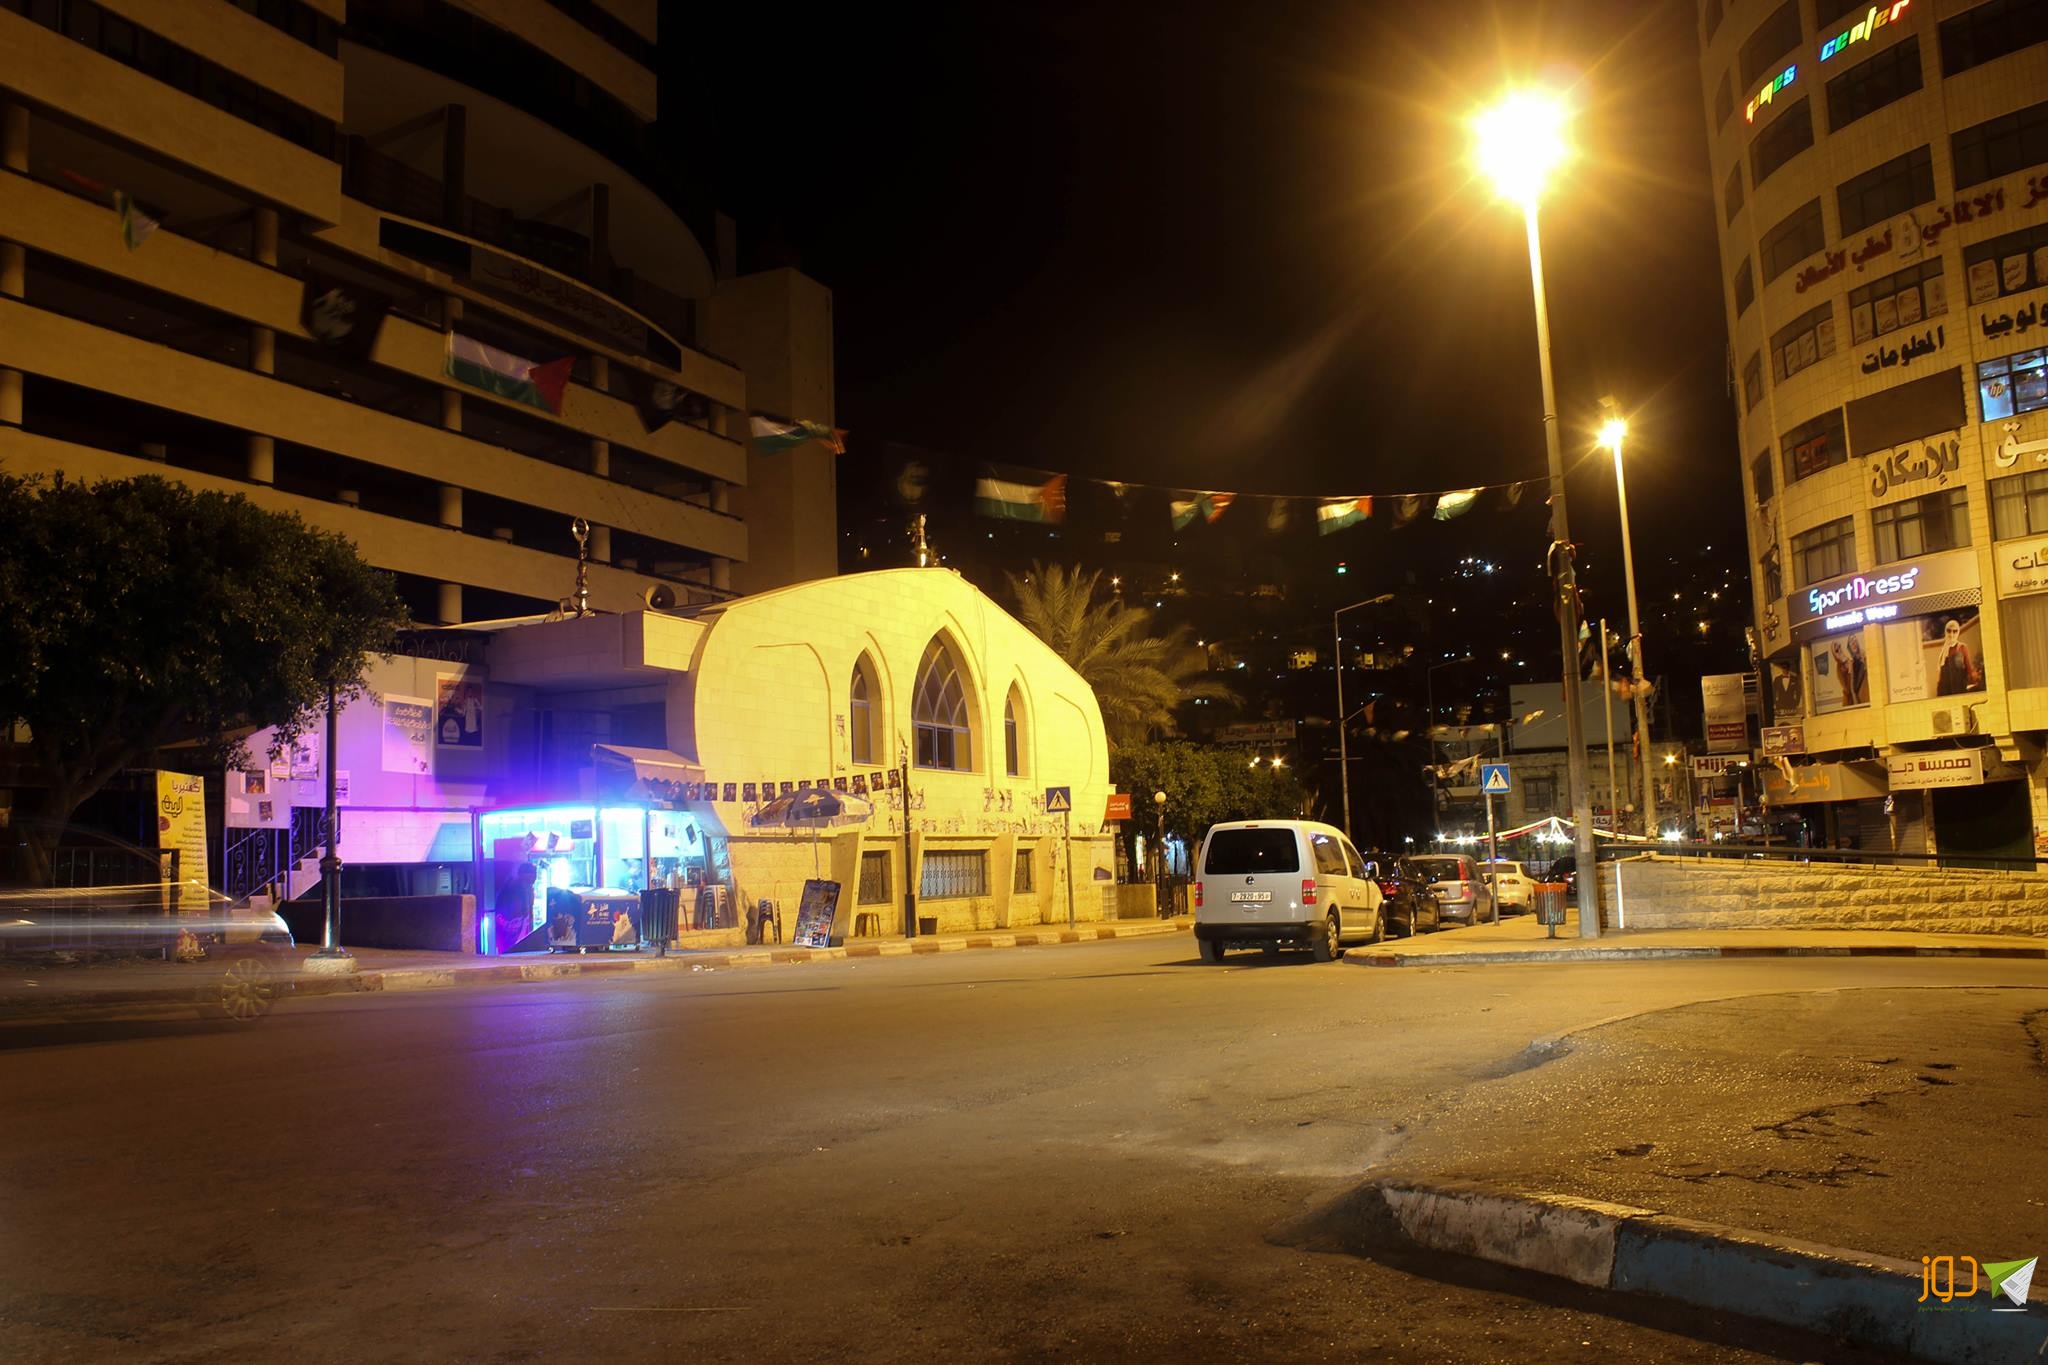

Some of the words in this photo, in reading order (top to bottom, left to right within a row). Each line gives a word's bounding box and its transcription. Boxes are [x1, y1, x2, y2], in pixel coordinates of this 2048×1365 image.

[1819, 0, 1912, 62] center
[1861, 325, 1944, 374] المعلومات
[1809, 568, 1919, 615] SportDress
